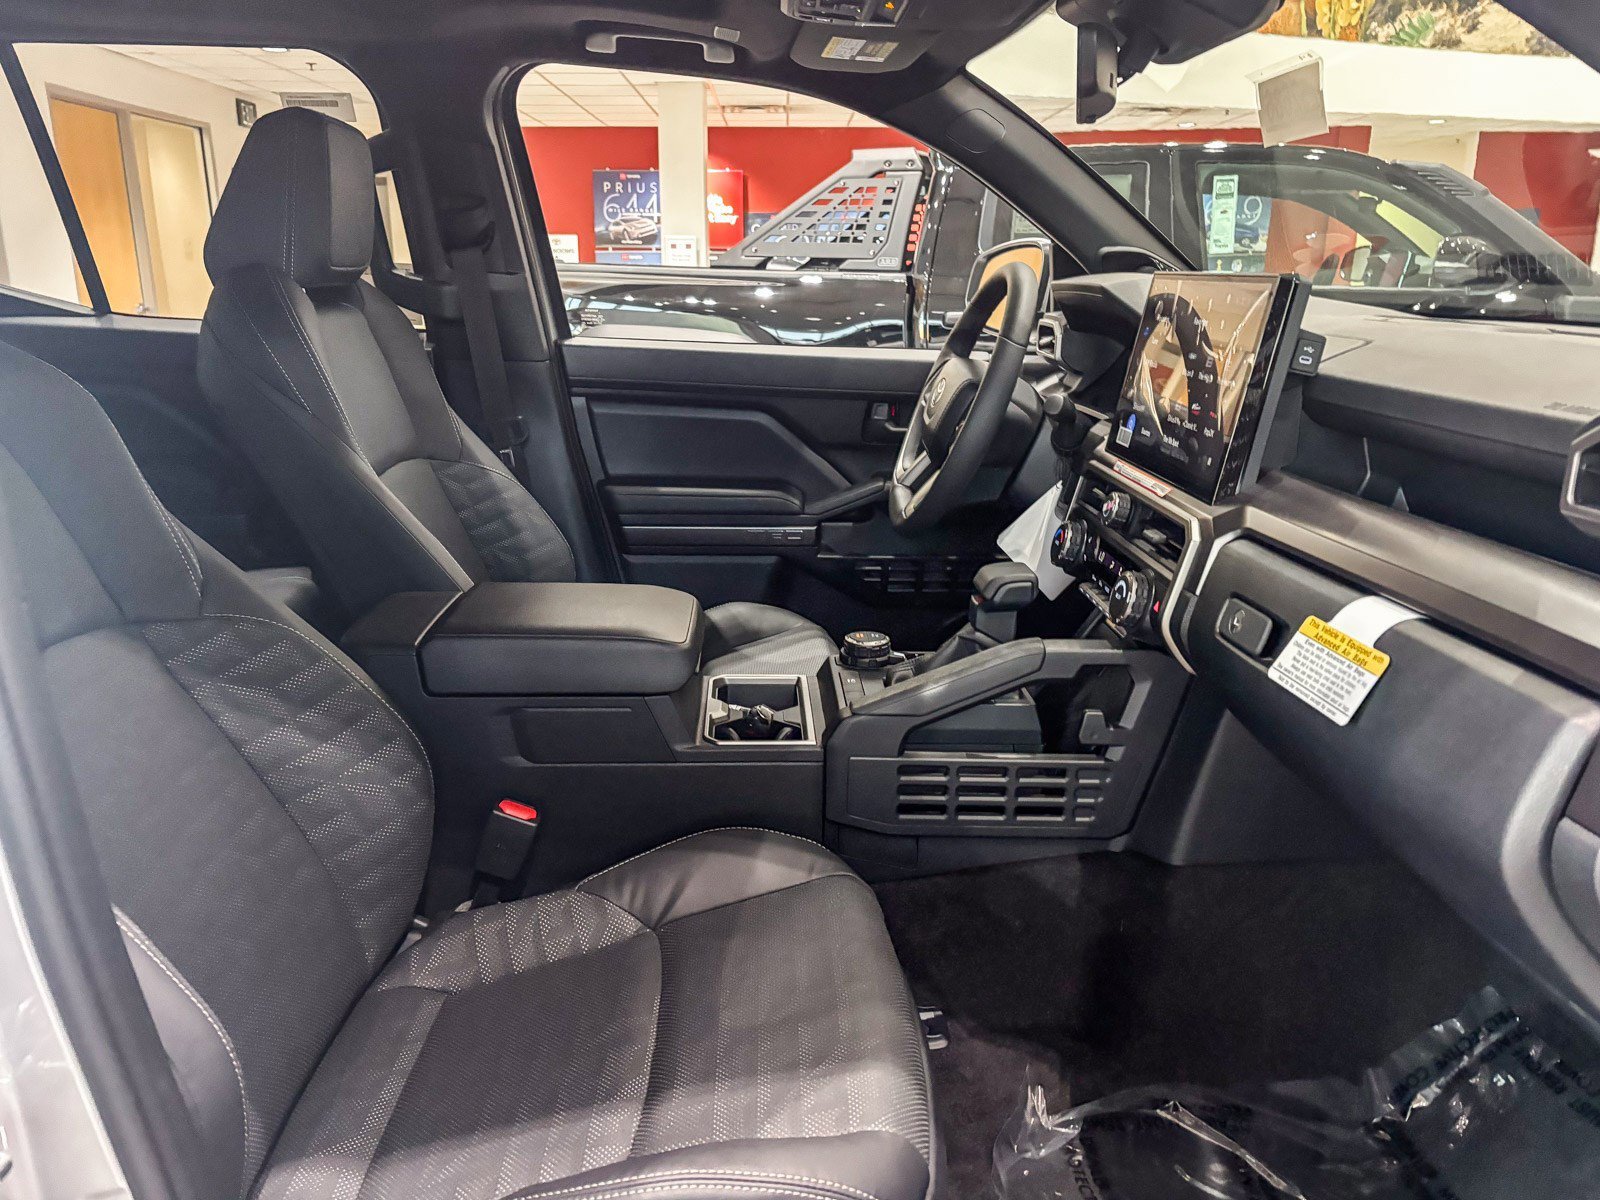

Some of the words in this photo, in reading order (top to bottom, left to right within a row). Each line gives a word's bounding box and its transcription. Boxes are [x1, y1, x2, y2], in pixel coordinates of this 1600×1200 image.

[603, 182, 658, 193] PRIUS
[603, 193, 661, 223] 644
[1309, 619, 1320, 628] This
[1321, 626, 1339, 638] Vehicle
[1346, 640, 1371, 656] Equipped
[1314, 633, 1340, 649] Advanced
[1342, 648, 1351, 656] Air
[1352, 655, 1367, 666] Bags
[1326, 652, 1345, 664] Advanced
